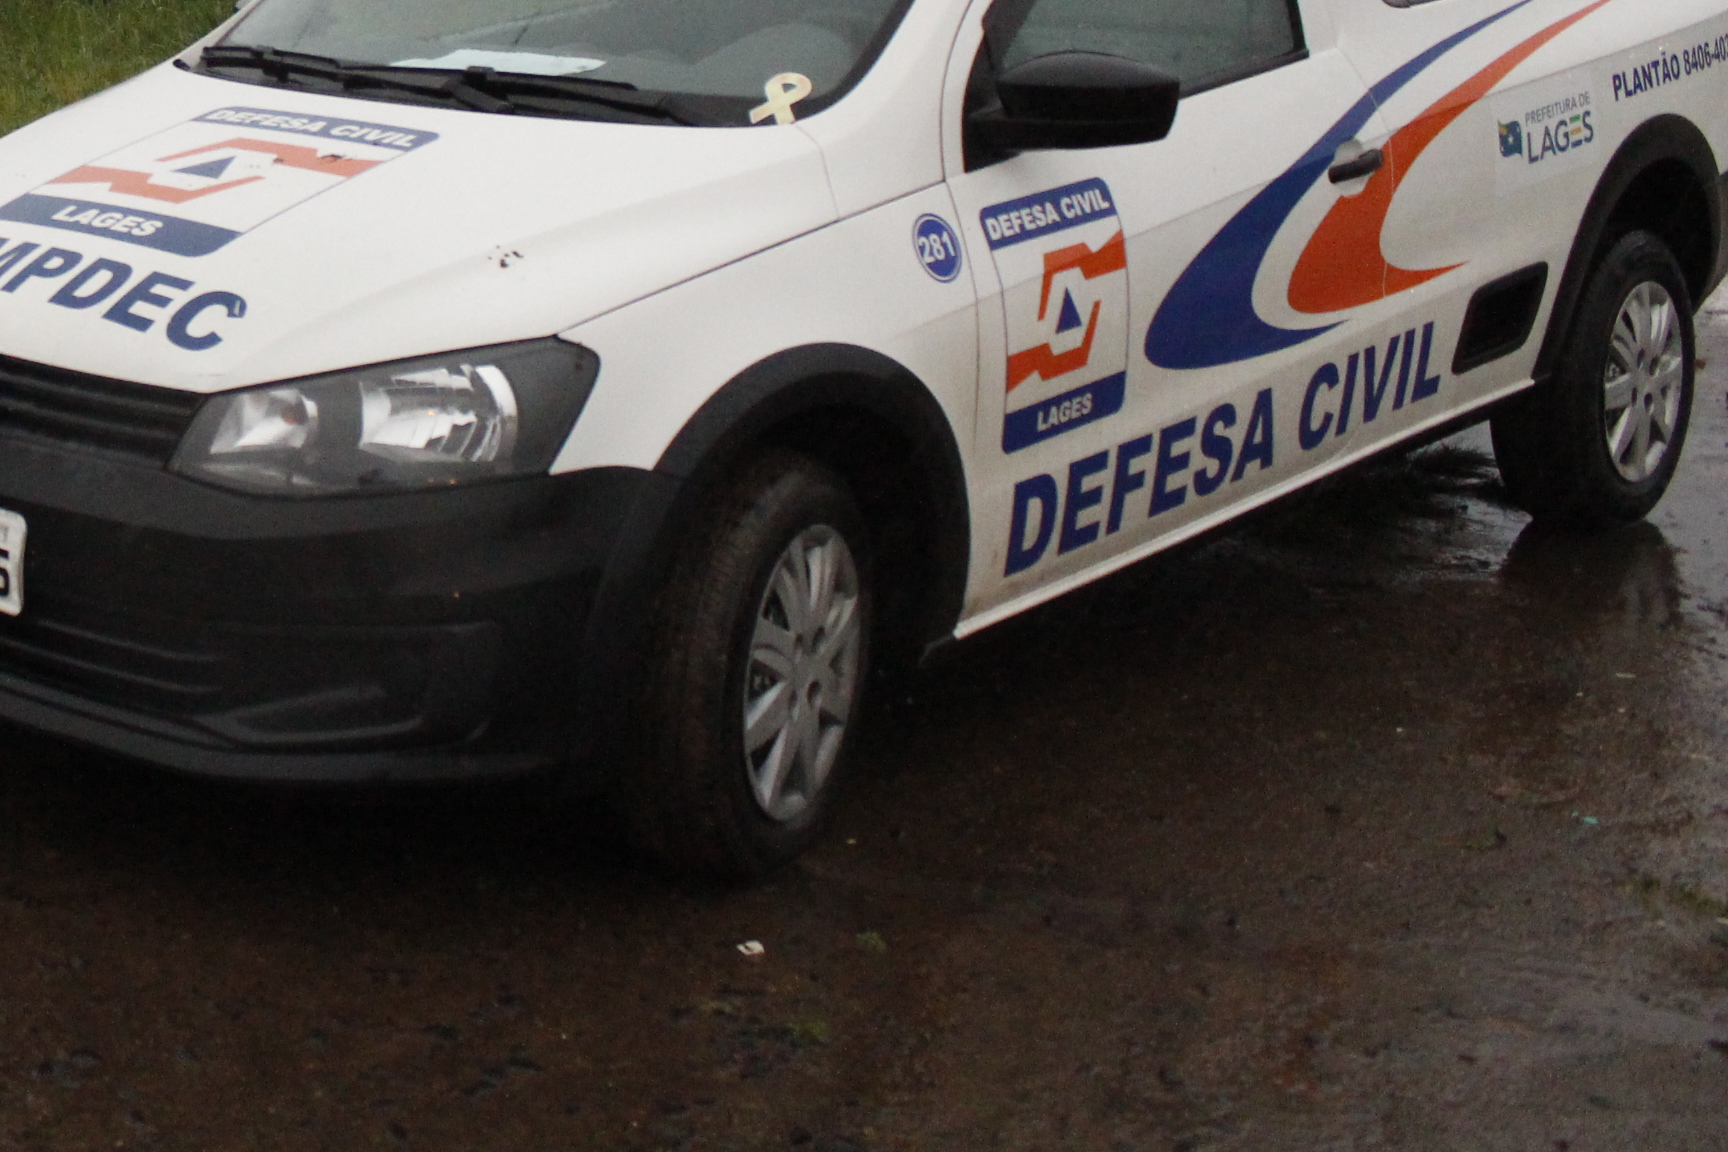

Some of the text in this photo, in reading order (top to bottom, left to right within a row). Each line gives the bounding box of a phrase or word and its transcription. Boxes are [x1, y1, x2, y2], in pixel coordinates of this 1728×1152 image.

[1612, 51, 1681, 102] PLANTÃO
[206, 109, 418, 147] DEFESA CIVIL
[1525, 91, 1591, 127] PREFEITURA DE
[1527, 110, 1594, 164] LAGES
[52, 204, 164, 237] LAGES
[984, 188, 1110, 241] DEFESA CIVIL
[917, 230, 957, 264] 281
[1036, 393, 1093, 432] LAGES
[1004, 321, 1441, 578] DEFESA CIVIL
